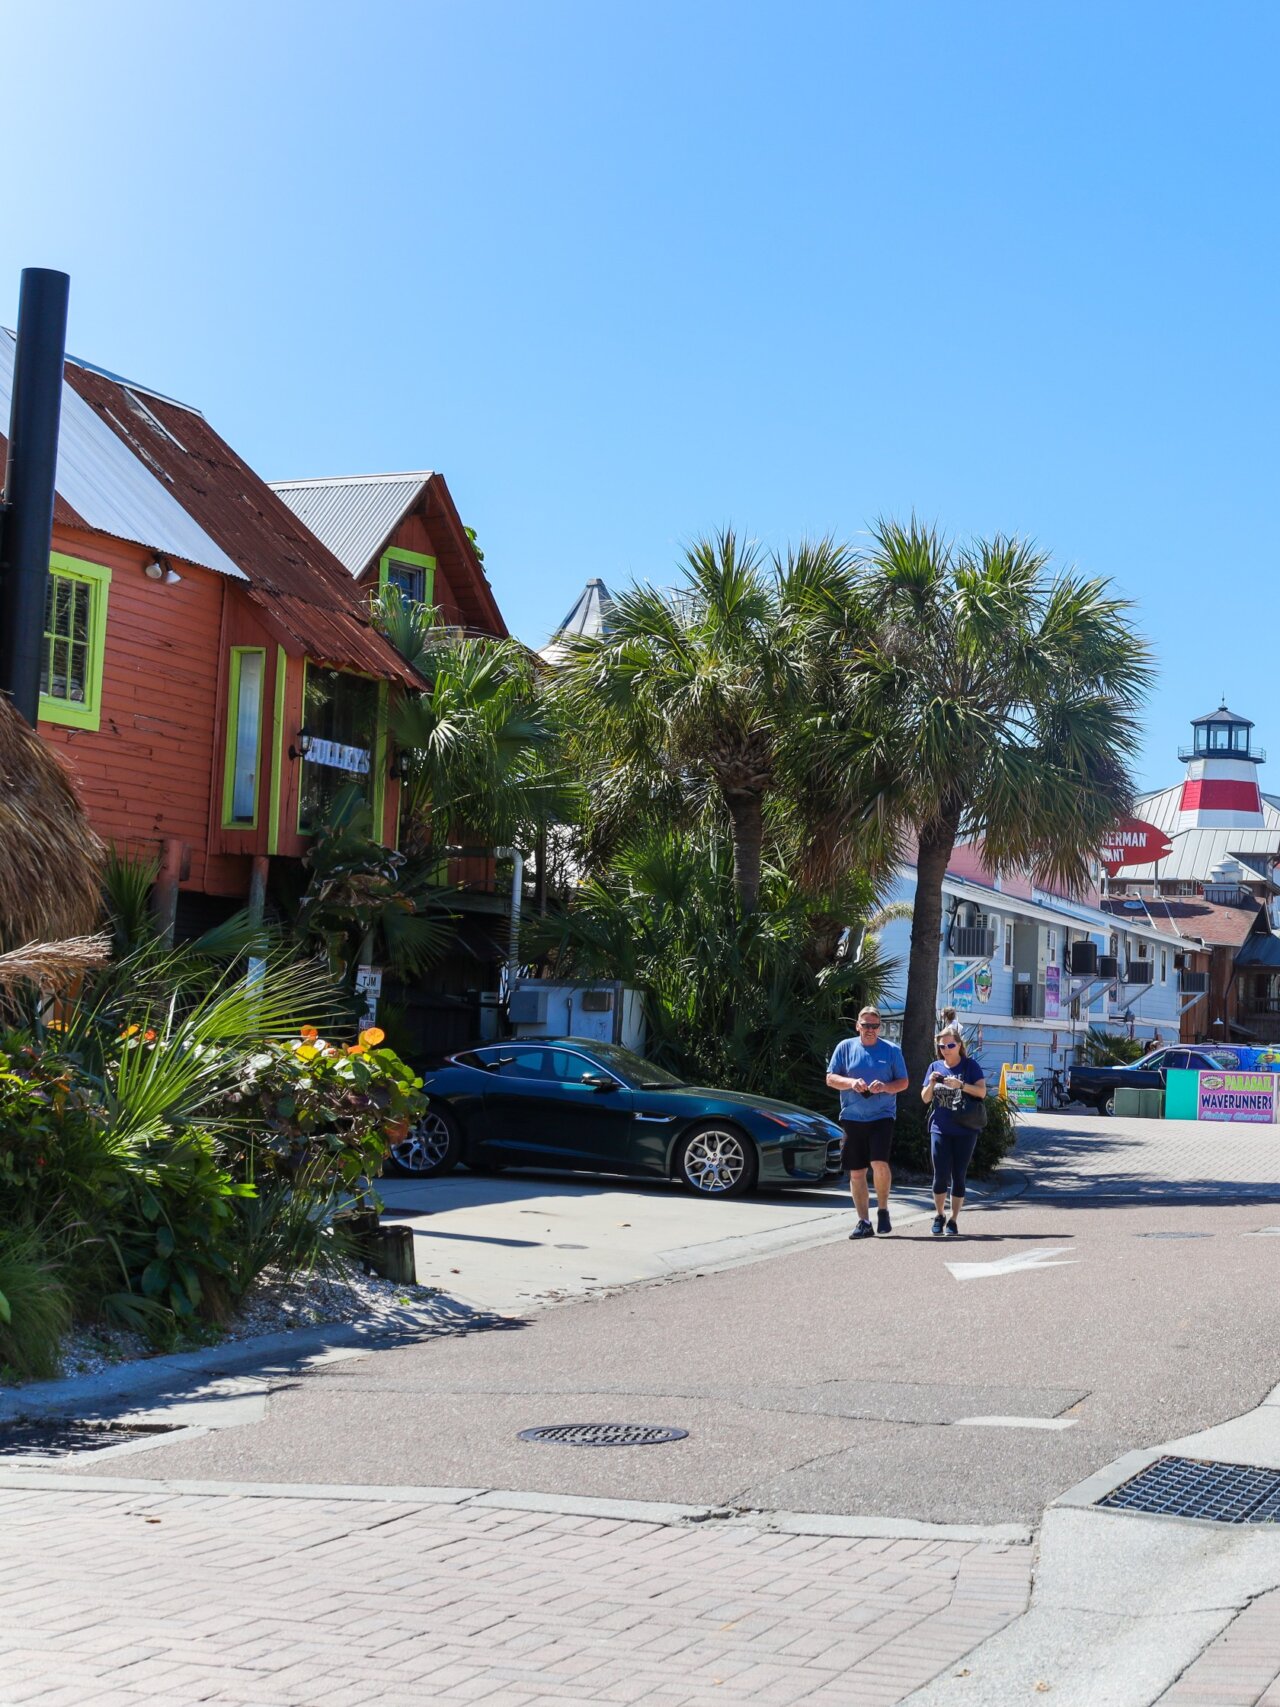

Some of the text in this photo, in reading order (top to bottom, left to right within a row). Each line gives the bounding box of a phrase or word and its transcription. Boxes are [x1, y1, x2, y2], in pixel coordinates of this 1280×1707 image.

[1101, 831, 1147, 847] HERMAN
[362, 976, 377, 987] TJM
[1225, 1075, 1273, 1092] PARASAIL
[1201, 1094, 1272, 1109] WAVERUNNERS
[1201, 1111, 1271, 1122] Fishing Charters
